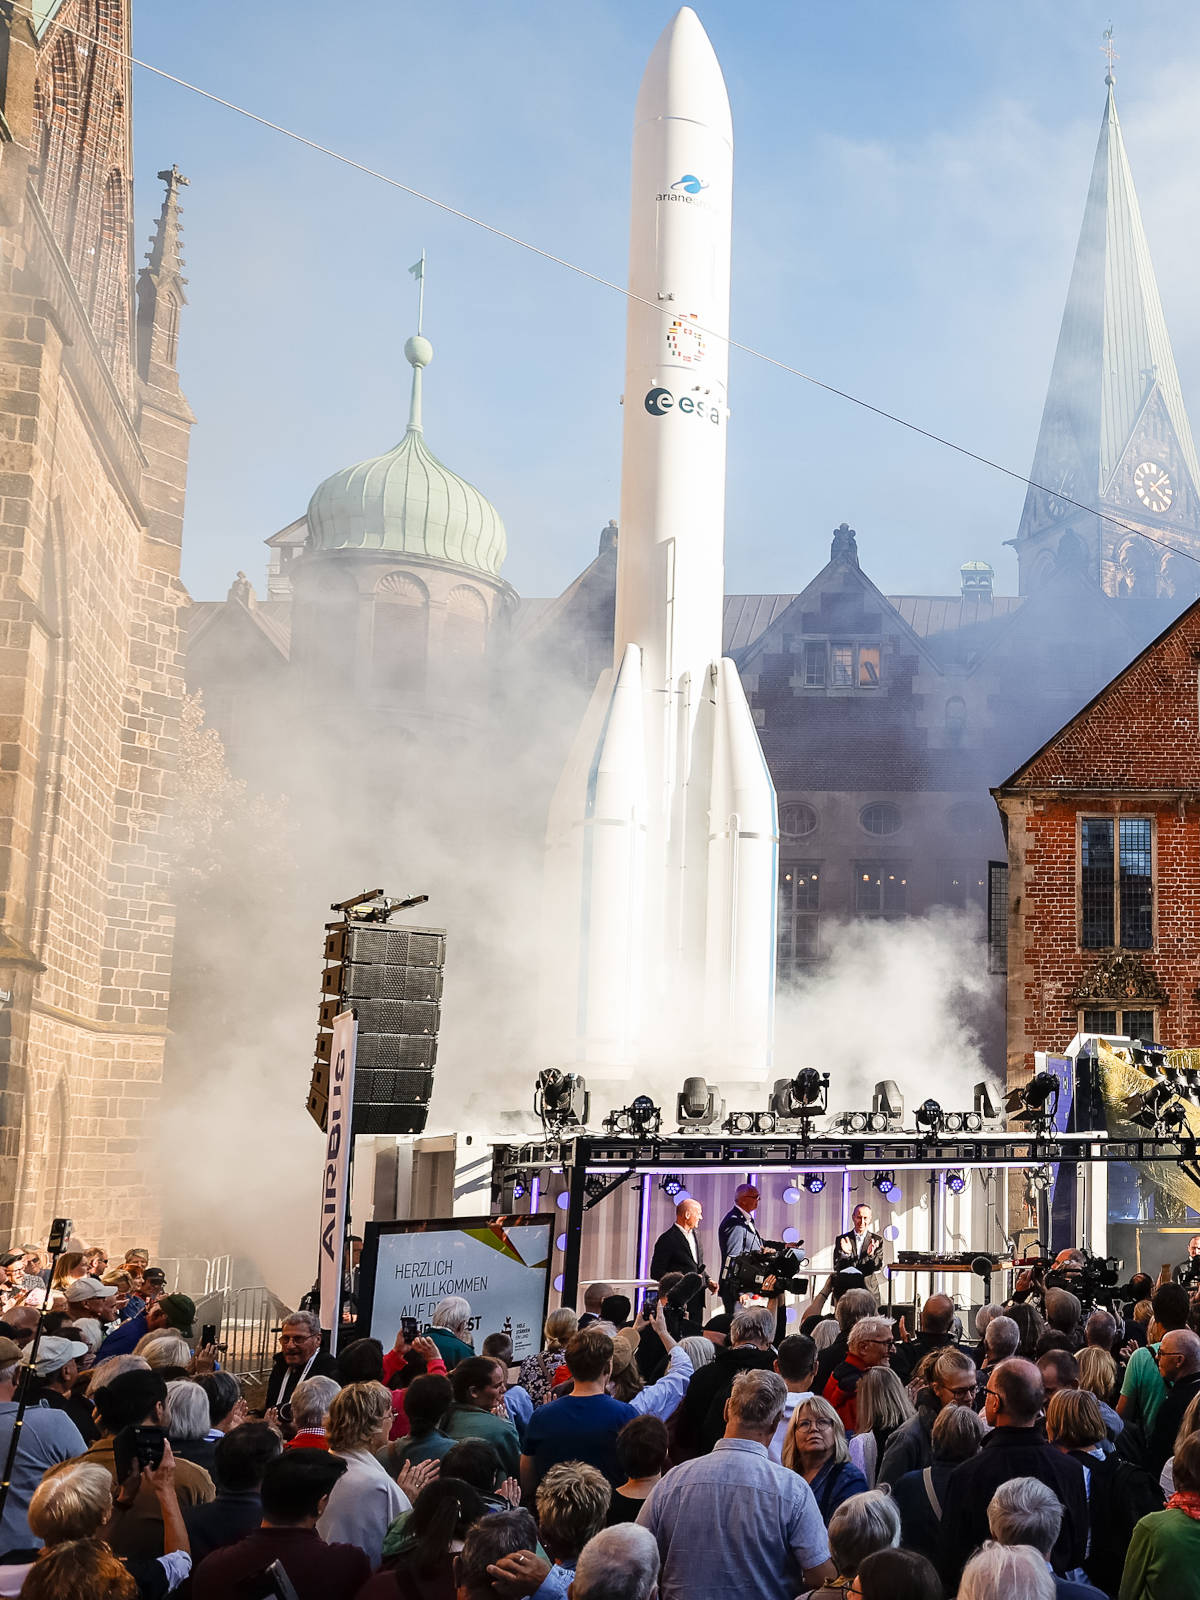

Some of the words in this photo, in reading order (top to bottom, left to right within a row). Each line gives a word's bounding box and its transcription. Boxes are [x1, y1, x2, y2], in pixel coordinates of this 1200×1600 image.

[679, 397, 719, 425] esa
[322, 1049, 345, 1263] AIRBUS
[395, 1260, 453, 1279] HERZLICH
[410, 1276, 488, 1298] WILLKOMMEN
[401, 1303, 424, 1318] AUF
